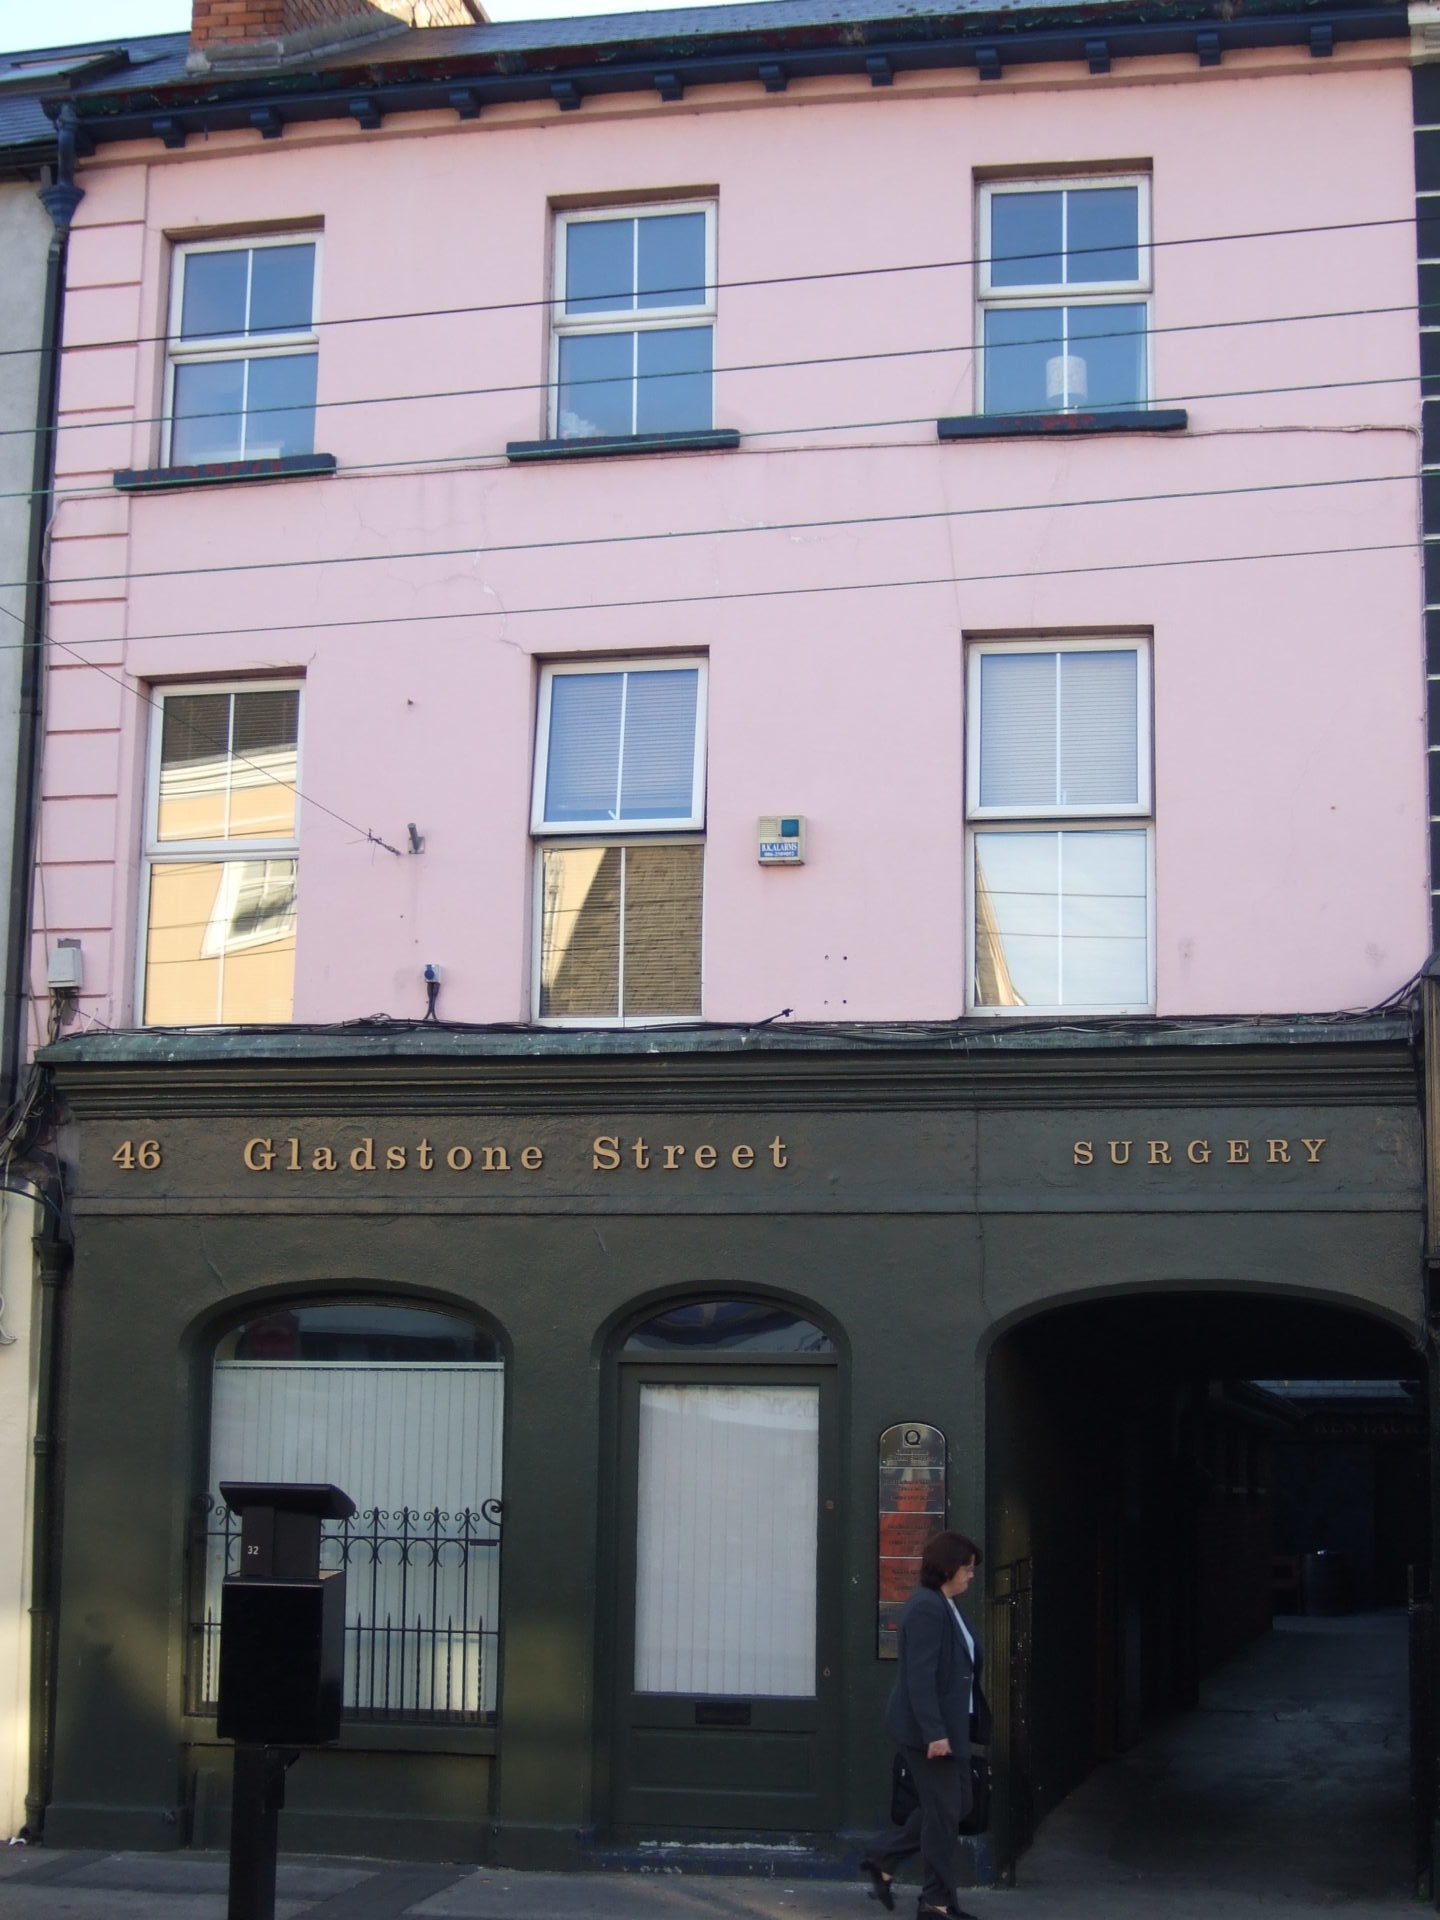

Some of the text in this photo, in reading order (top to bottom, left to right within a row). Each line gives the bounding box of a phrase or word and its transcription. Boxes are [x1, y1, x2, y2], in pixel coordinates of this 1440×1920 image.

[111, 1135, 789, 1171] 46 Gladstone Street
[1073, 1138, 1326, 1165] SURGERY
[247, 1545, 259, 1555] 32
